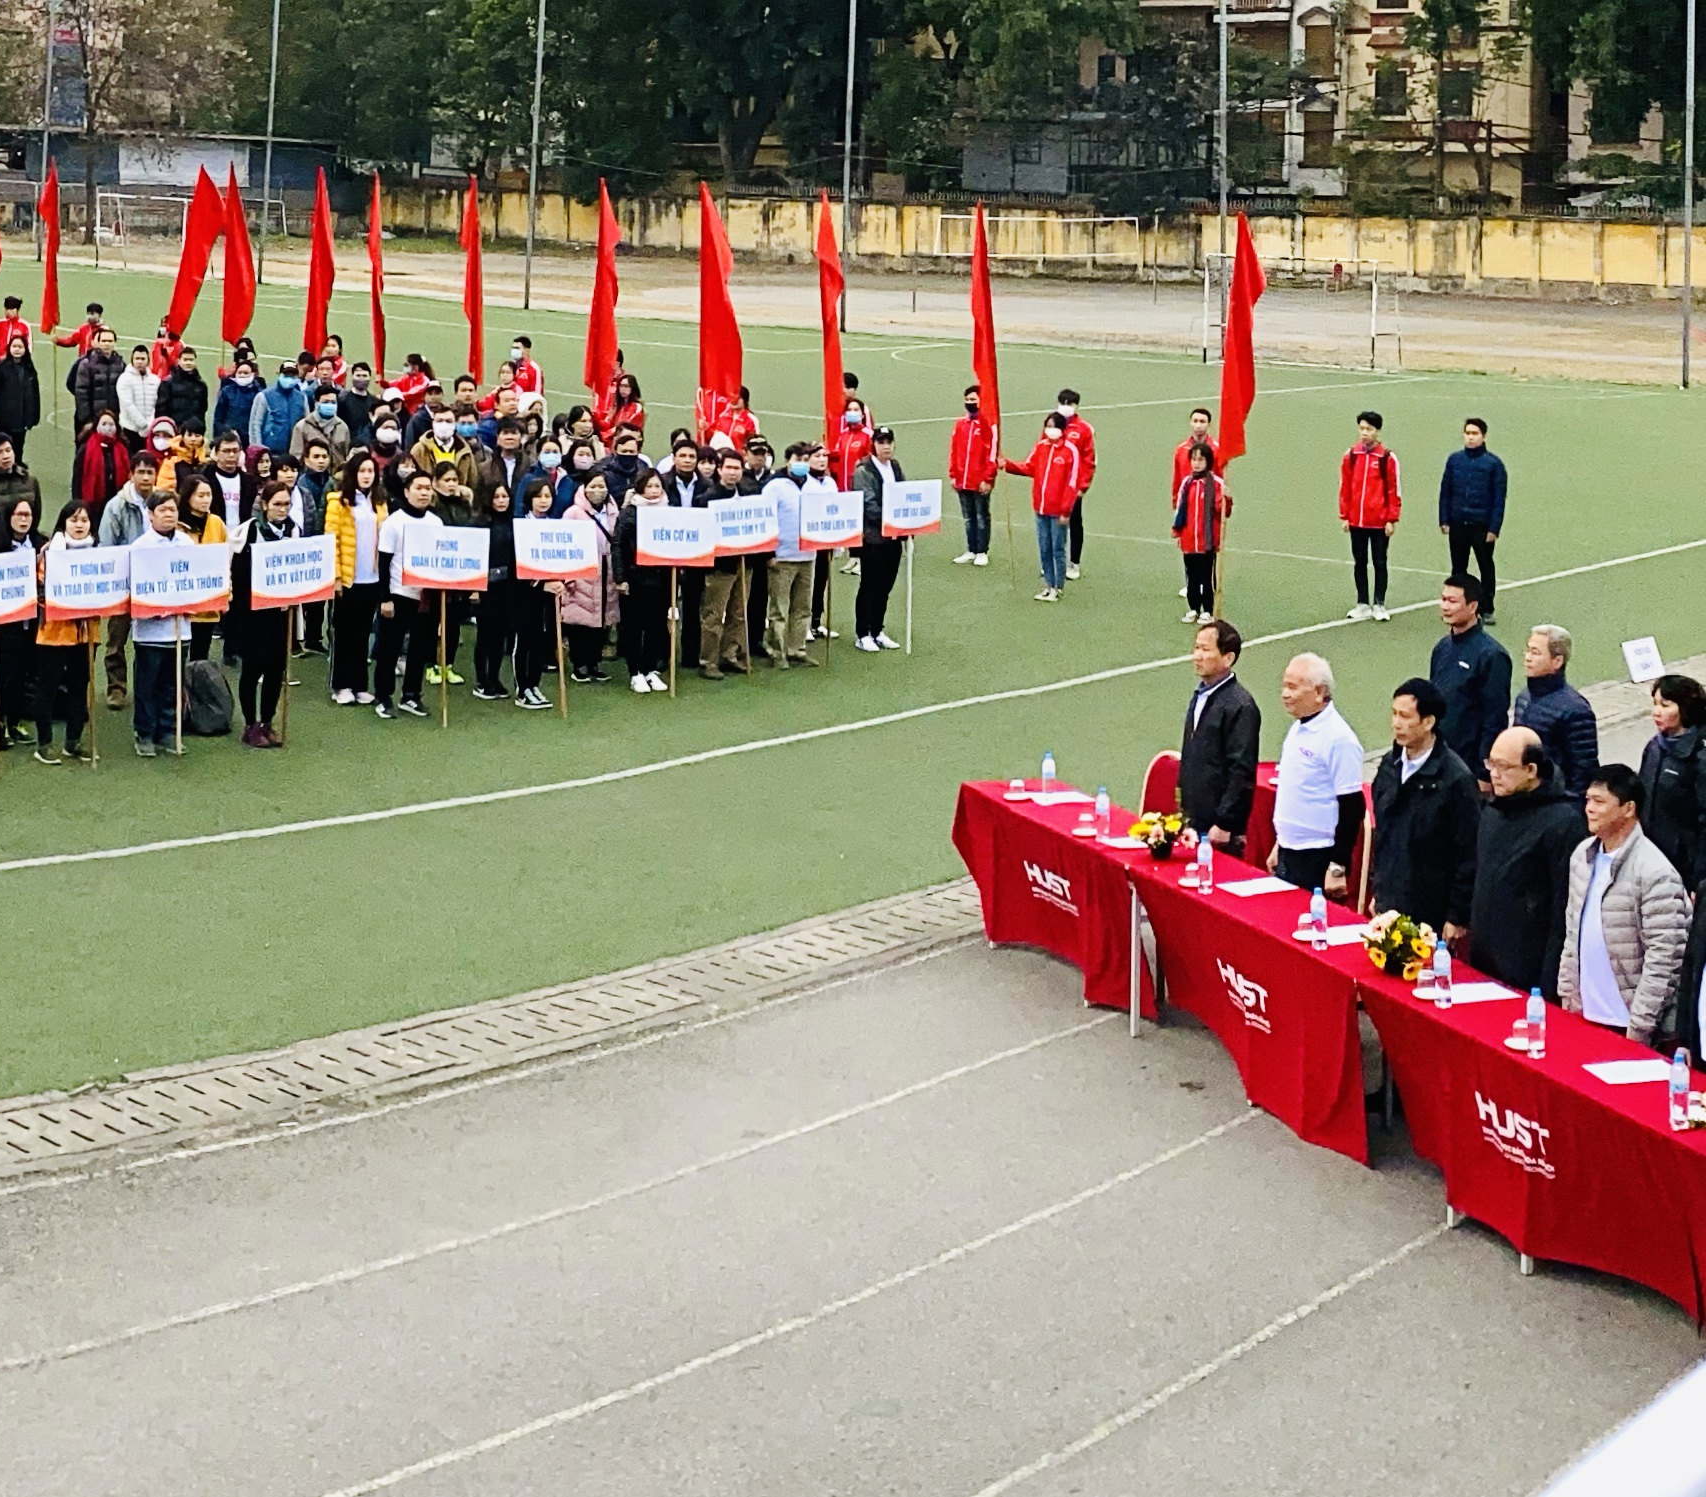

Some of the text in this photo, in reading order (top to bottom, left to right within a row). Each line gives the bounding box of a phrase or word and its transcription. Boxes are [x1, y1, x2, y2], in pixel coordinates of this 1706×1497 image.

[555, 531, 572, 545] VIỆN
[653, 526, 671, 542] VIỆN
[673, 529, 684, 542] CƠ
[170, 559, 189, 576] VIỆN
[265, 549, 322, 571] VIỆN KHOA HỌC
[266, 570, 276, 586] VÀ
[1024, 860, 1071, 900] HUST
[1217, 957, 1268, 1013] HUST
[1475, 1091, 1549, 1155] HUST
